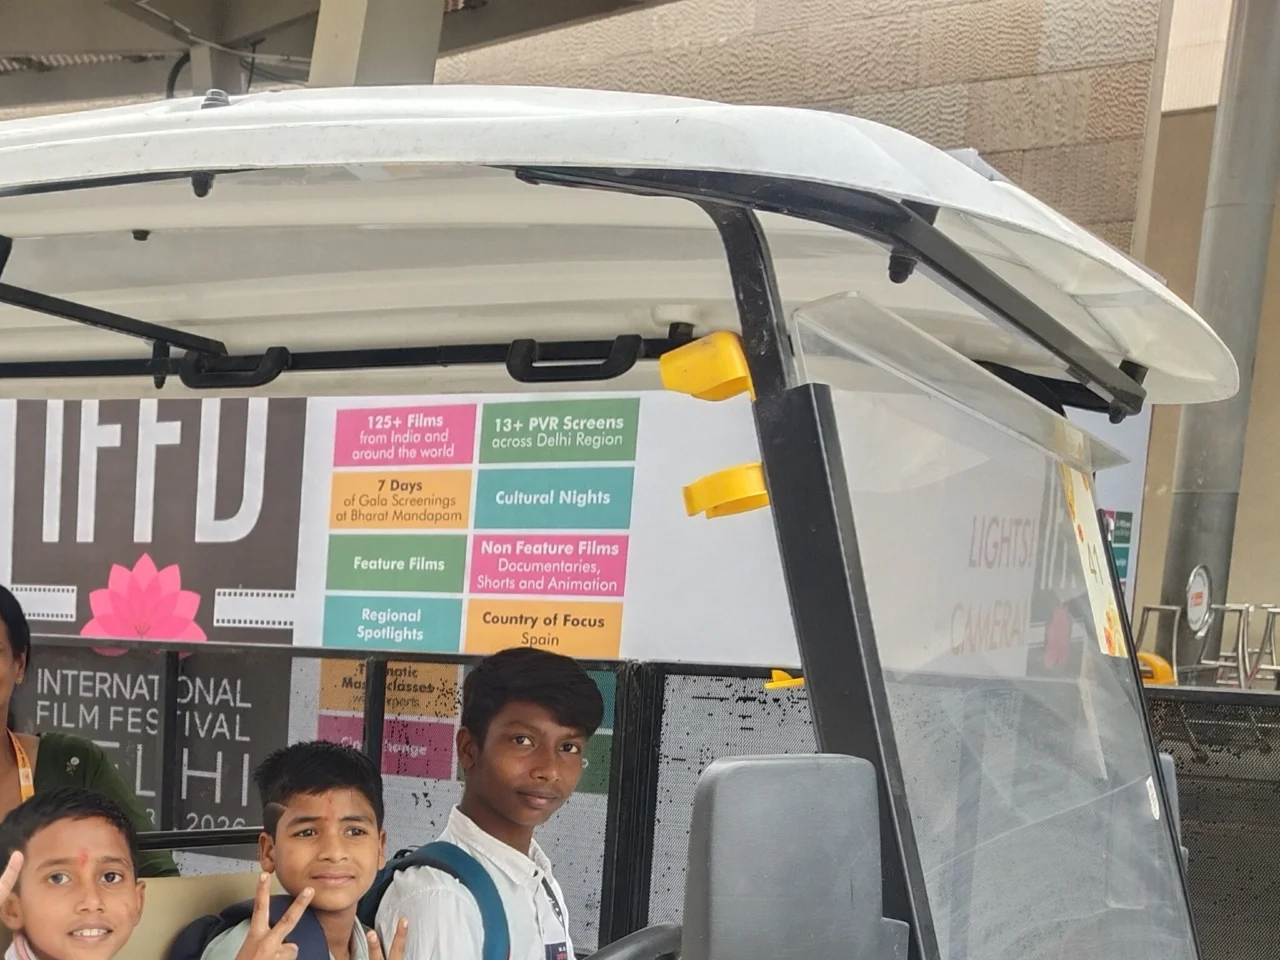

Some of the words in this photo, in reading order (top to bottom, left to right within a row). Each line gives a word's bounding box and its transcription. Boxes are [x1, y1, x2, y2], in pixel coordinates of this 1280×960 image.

[367, 415, 402, 430] 125+
[407, 413, 444, 428] Films
[494, 418, 524, 433] 13+
[528, 416, 559, 432] PVR
[562, 415, 625, 431] Screens
[359, 431, 387, 445] from
[390, 429, 421, 444] India
[424, 428, 449, 443] and
[491, 437, 533, 449] across
[536, 431, 572, 448] Delhi
[575, 431, 623, 450] Region
[351, 446, 395, 461] around
[398, 446, 417, 459] the
[419, 443, 455, 458] world
[41, 398, 269, 543] IFFD
[377, 480, 386, 493] 7
[390, 480, 423, 495] Days
[343, 494, 356, 507] of
[358, 494, 389, 508] Gala
[391, 493, 457, 510] Screenings
[494, 489, 555, 505] Cultural
[558, 489, 612, 508] Nights
[335, 510, 348, 522] at
[350, 509, 389, 522] Bharat
[391, 509, 463, 525] Mandapam
[480, 540, 512, 555] Non
[515, 540, 574, 556] Feature
[577, 540, 620, 556] Films
[968, 515, 1037, 570] LIGHTS!
[353, 556, 405, 571] Feature
[408, 556, 446, 572] Films
[498, 557, 601, 576] Documentaries,
[477, 574, 516, 590] Shorts
[519, 576, 545, 590] and
[548, 576, 618, 592] Animation
[361, 607, 422, 625] Regional
[482, 611, 539, 630] Country
[543, 612, 559, 627] of
[562, 613, 606, 629] Focus
[356, 625, 424, 643] Spotlights
[521, 631, 560, 648] Spain
[358, 663, 418, 678] Tmatic
[36, 668, 252, 709] INTERNATONAL
[35, 701, 99, 731] FILM
[109, 706, 251, 743] FESIVAL
